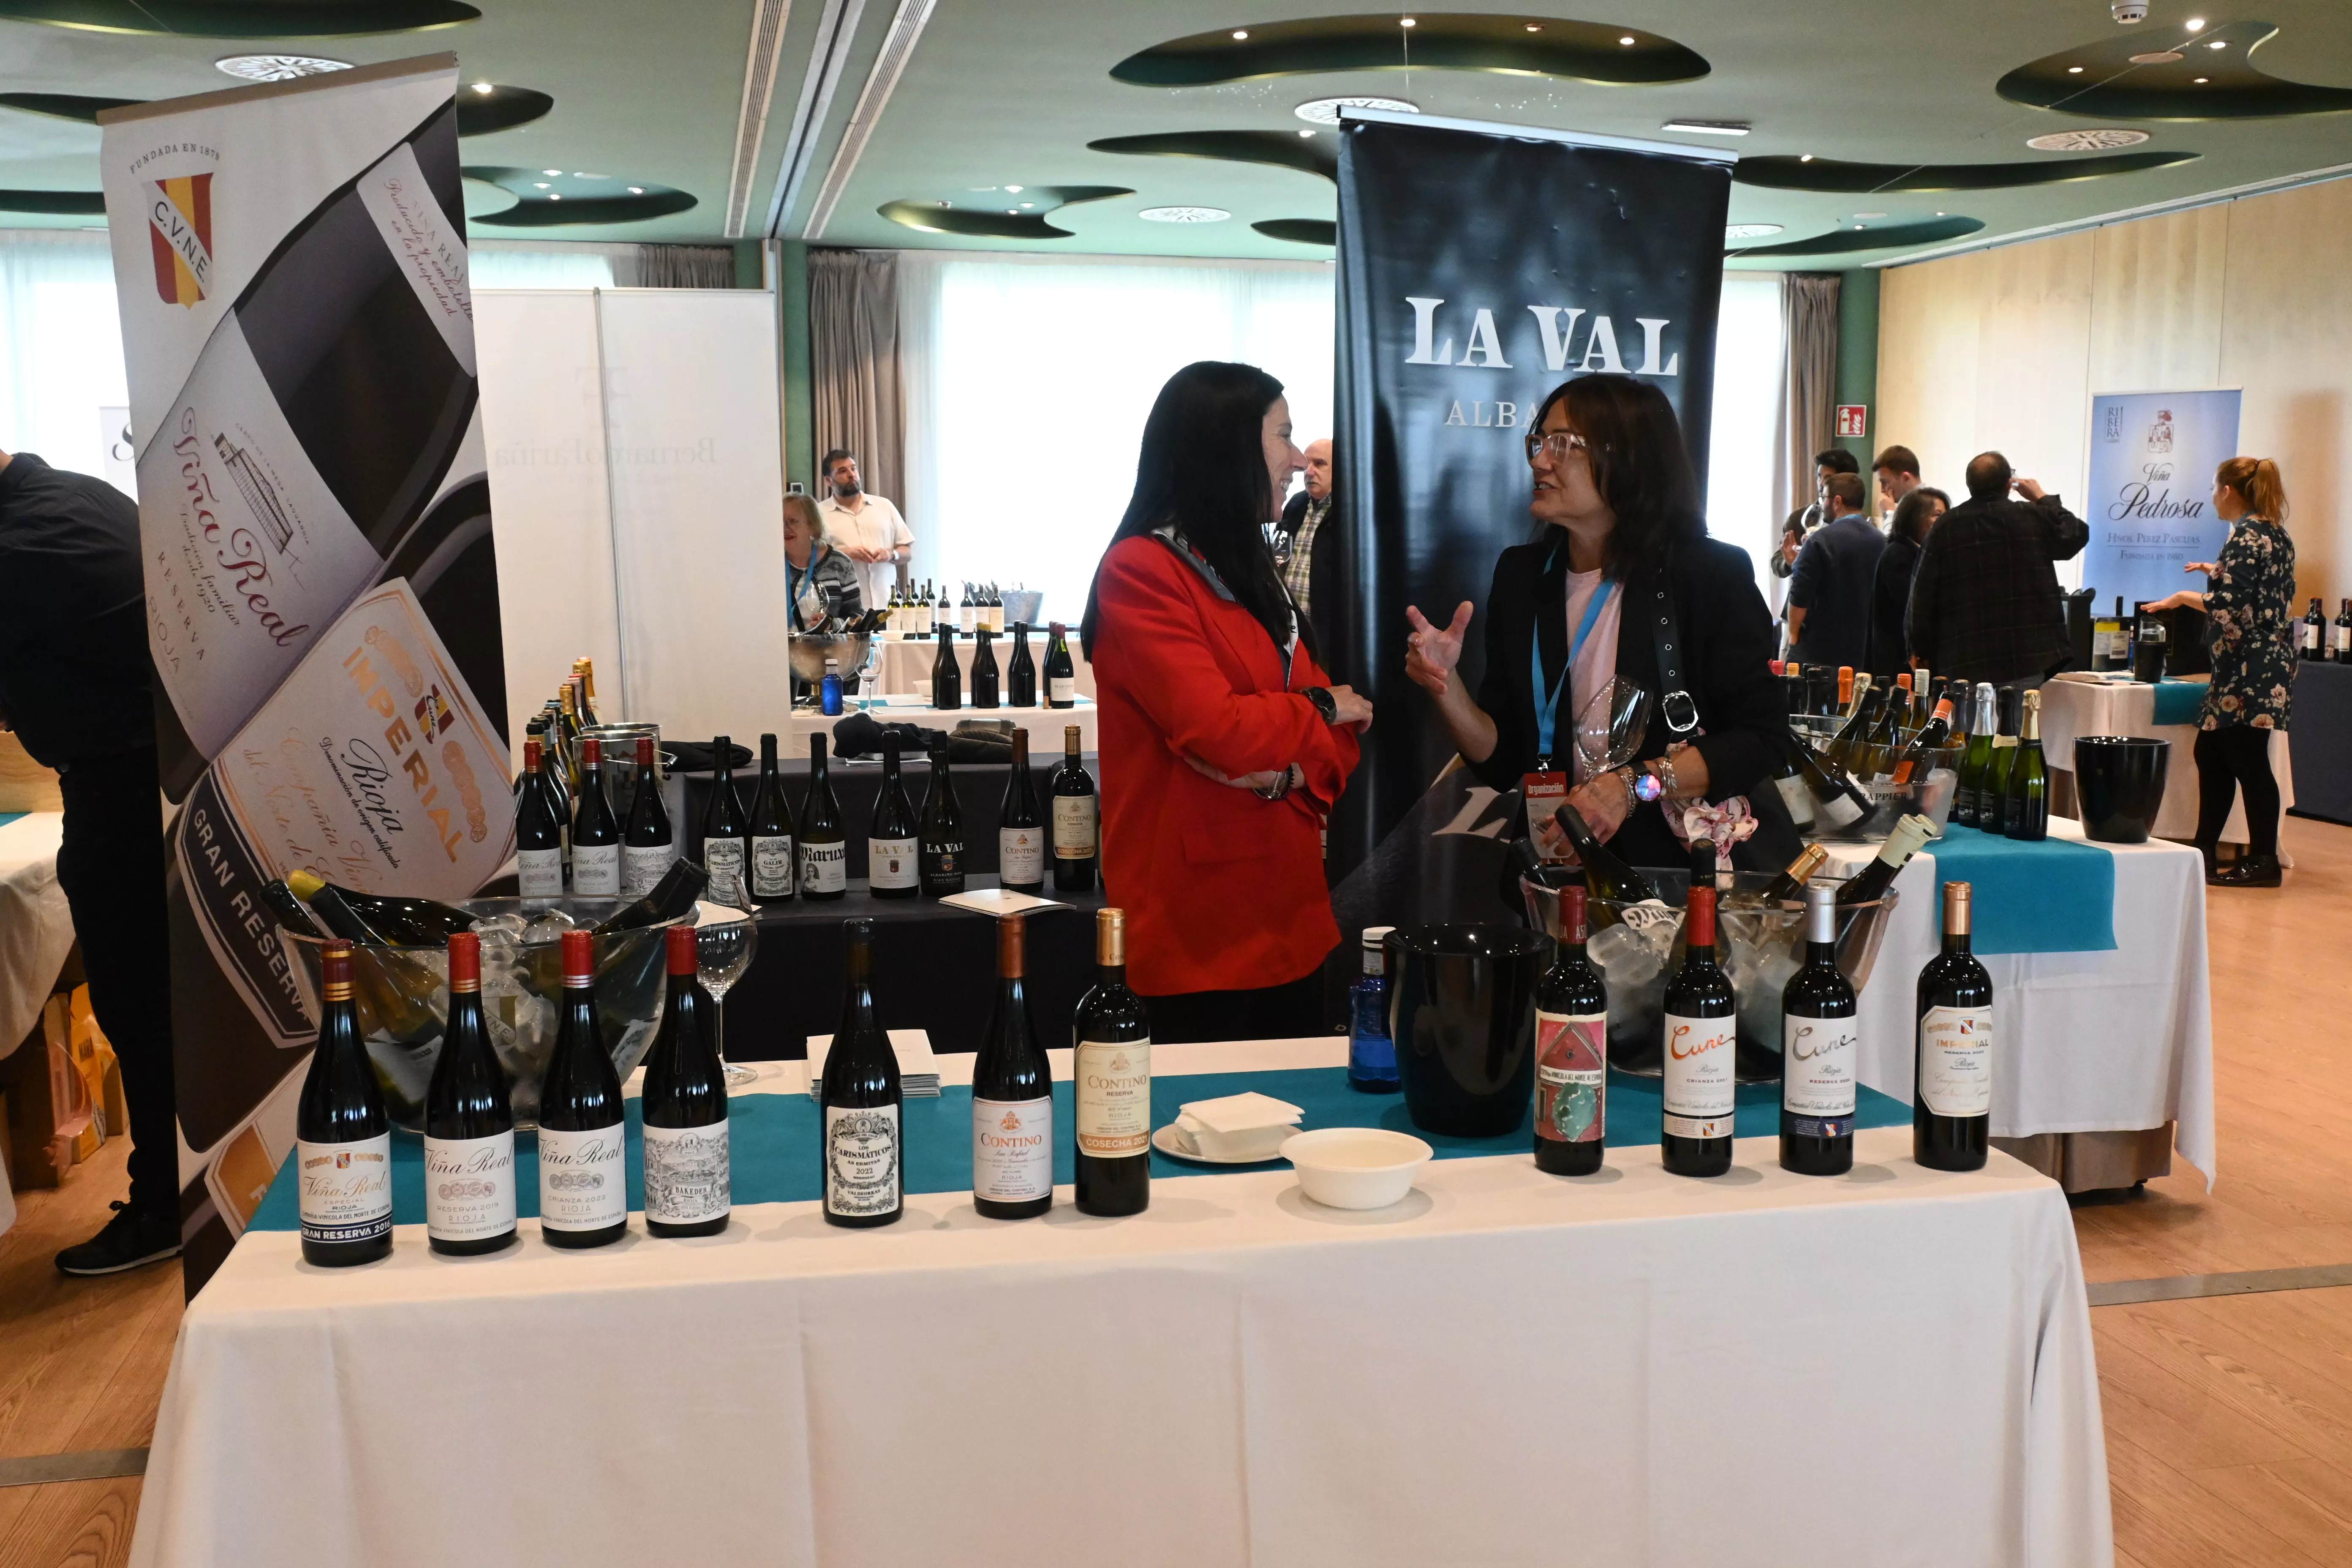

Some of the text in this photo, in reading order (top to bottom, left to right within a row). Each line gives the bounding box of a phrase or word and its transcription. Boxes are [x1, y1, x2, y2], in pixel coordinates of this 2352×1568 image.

[130, 143, 220, 174] FUNDADA EN 1879
[384, 178, 424, 243] Producido
[419, 248, 431, 257] y
[392, 220, 457, 316] en la propiedad
[1406, 297, 1678, 376] LA VAL
[1444, 400, 1540, 430] ALBA
[2143, 463, 2174, 483] Viña
[2108, 482, 2205, 520] Pedrosa
[173, 407, 309, 647] Viña Real
[158, 551, 204, 660] RESERVA
[196, 583, 215, 612] 1920
[201, 574, 240, 627] familiar
[149, 596, 181, 673] RIOJA
[342, 646, 463, 863] IMPERIAL
[341, 738, 404, 835] Rioja
[1528, 782, 1564, 795] Organización
[319, 737, 401, 869] Denominación de origen calificada
[1058, 814, 1092, 822] CONTINO
[591, 850, 618, 865] Real
[875, 846, 889, 854] LA
[926, 842, 964, 853] LA VAL
[1005, 846, 1040, 854] CONTINO
[194, 808, 309, 1021] GRAN RESERVA
[1671, 1025, 1735, 1061] Cune
[1792, 1026, 1857, 1062] Cune
[1936, 1039, 1989, 1048] IMPERIAL
[1088, 1074, 1147, 1090] CONTINO
[538, 1134, 623, 1165] Viña Real
[981, 1132, 1042, 1148] CONTINO
[1086, 1135, 1148, 1148] COSECHA 2021
[424, 1142, 514, 1174] Viña Real
[304, 1170, 387, 1198] Viña Real
[675, 1186, 708, 1195] BAKEDER
[480, 1202, 499, 1211] 2019
[548, 1195, 607, 1203] CRIANZA 2022
[561, 1205, 592, 1213] RIOJA
[302, 1220, 391, 1240] GRAN RESERVA 2016
[448, 1213, 486, 1222] RIOJA
[476, 1225, 492, 1233] NORTE
